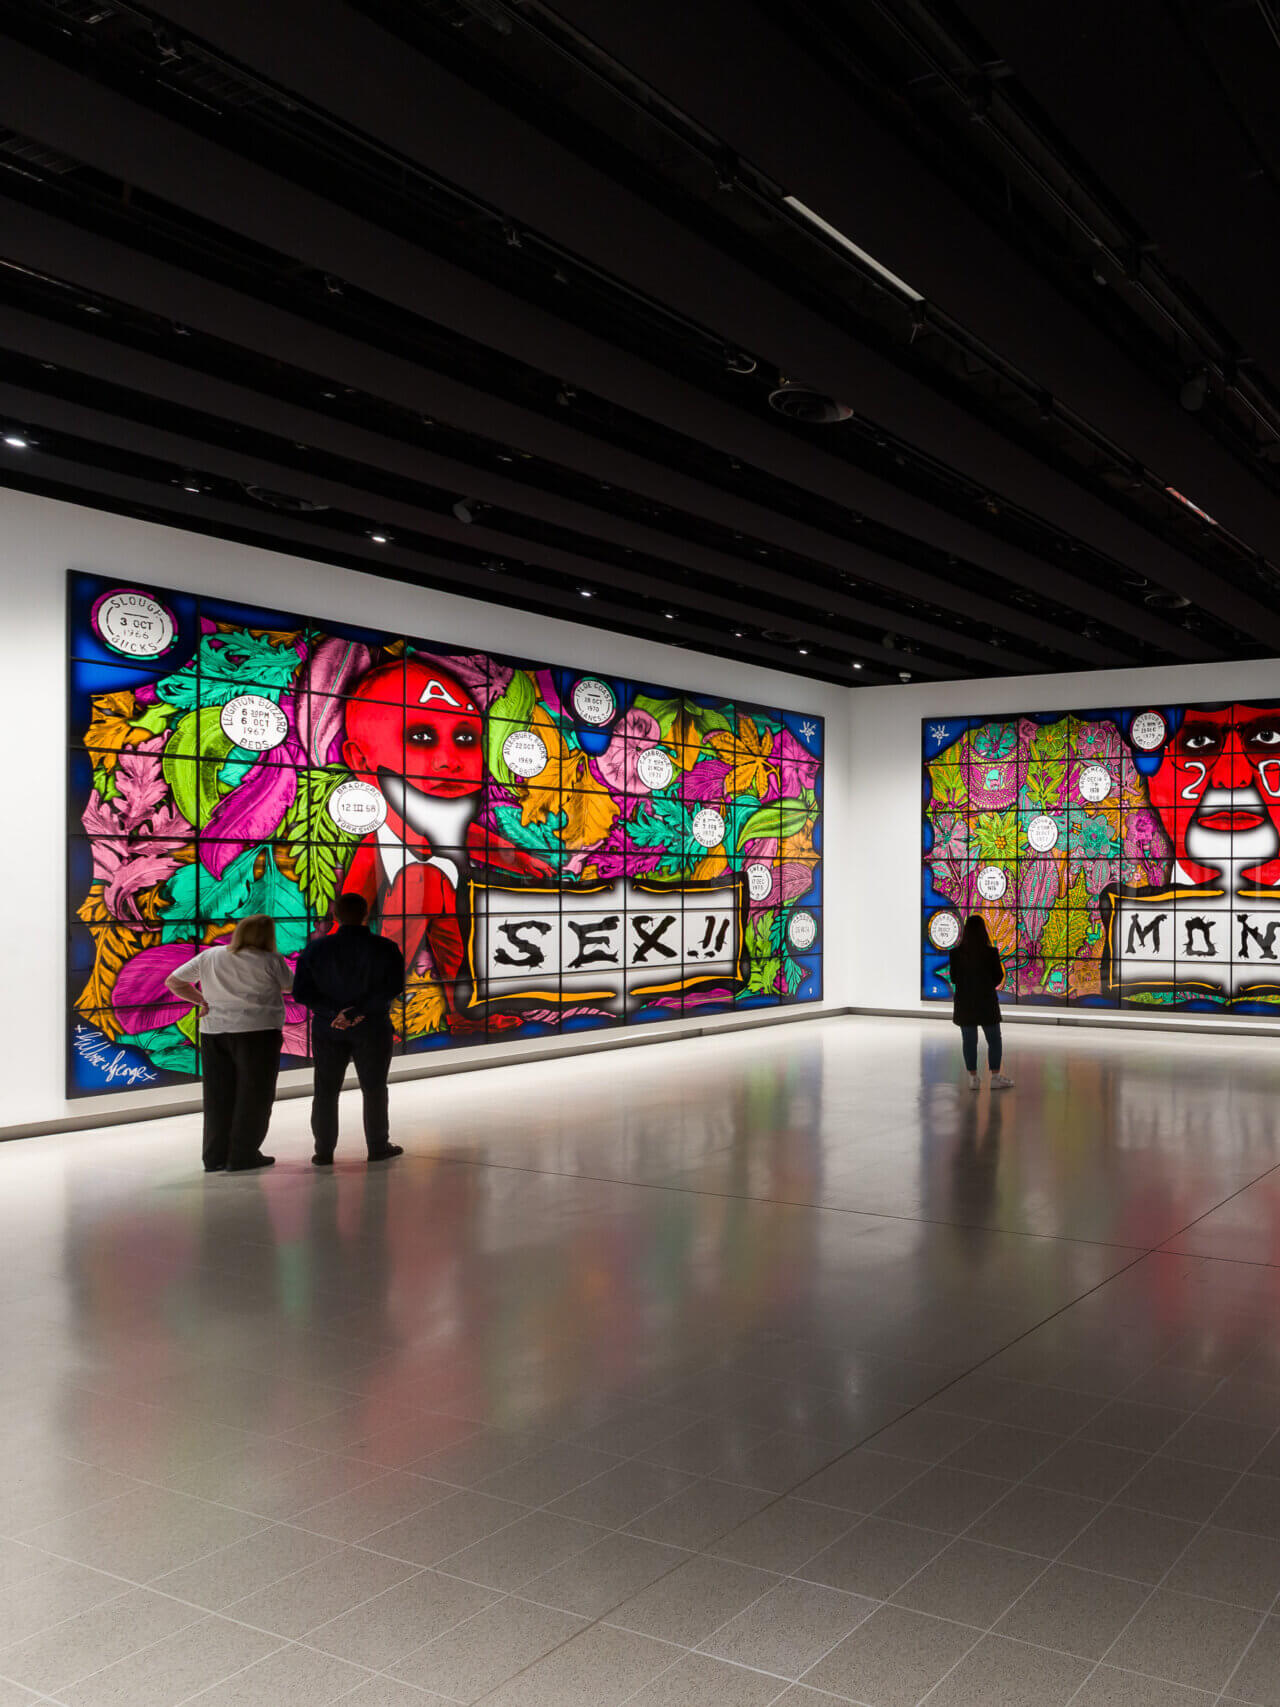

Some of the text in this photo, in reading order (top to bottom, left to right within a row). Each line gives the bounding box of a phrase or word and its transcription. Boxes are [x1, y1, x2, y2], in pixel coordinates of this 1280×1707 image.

[119, 617, 154, 630] 3 OCT
[223, 696, 287, 733] LEIGHTON BUZZARD
[240, 717, 270, 728] 6 OCT
[243, 727, 266, 736] 1967
